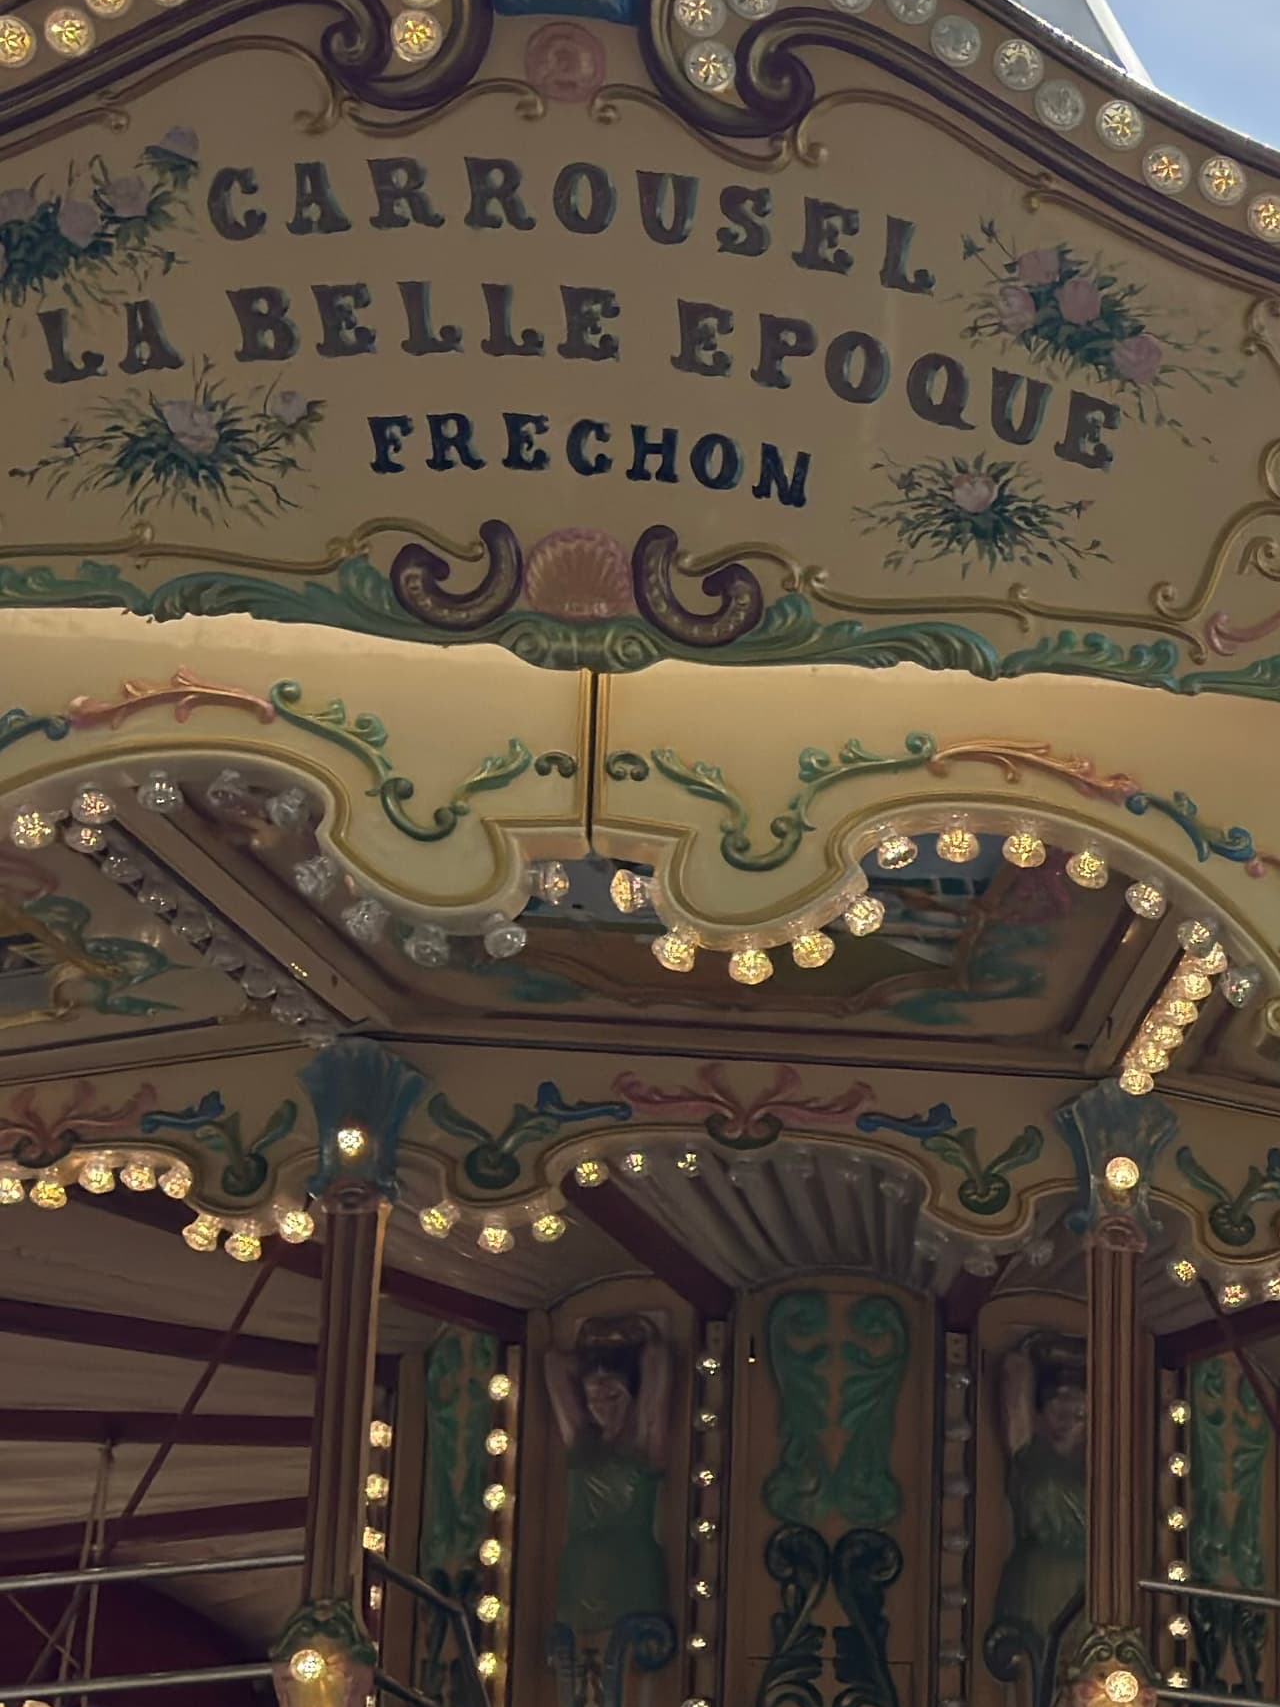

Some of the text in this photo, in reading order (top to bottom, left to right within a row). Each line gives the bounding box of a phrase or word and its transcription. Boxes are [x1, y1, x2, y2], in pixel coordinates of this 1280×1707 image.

[207, 155, 936, 295] CARROUSEL
[37, 280, 1121, 470] LA BELLE EPOQUE
[367, 410, 813, 507] FRECHON
